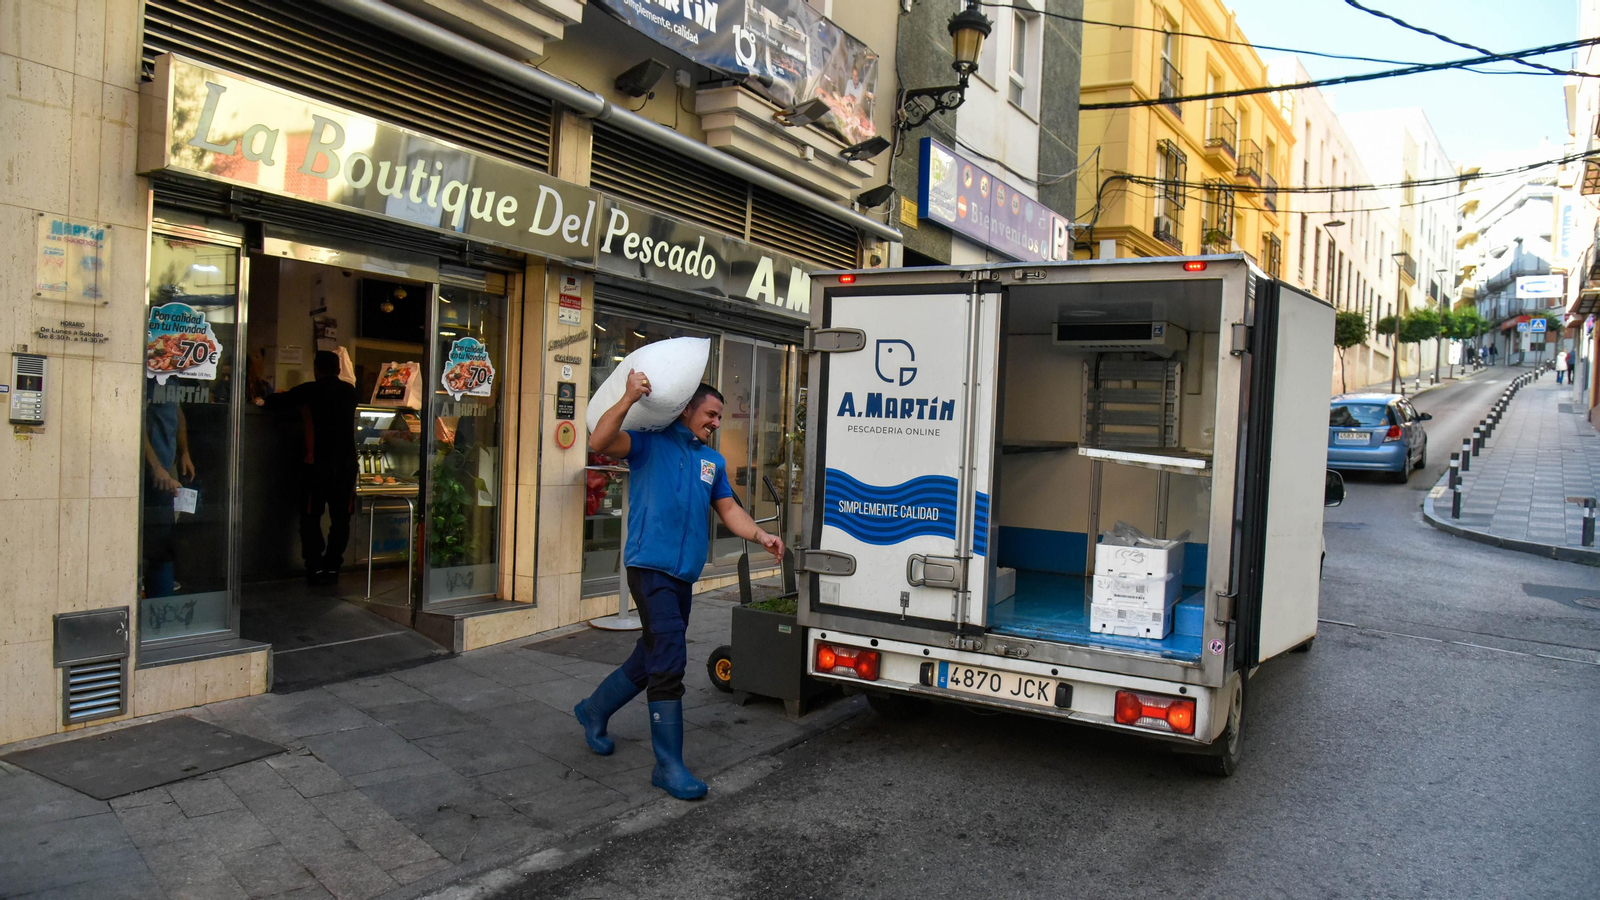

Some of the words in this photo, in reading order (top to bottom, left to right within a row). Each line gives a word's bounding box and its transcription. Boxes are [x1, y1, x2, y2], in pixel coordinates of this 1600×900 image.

[673, 24, 699, 45] calidad
[188, 80, 280, 167] La
[297, 114, 519, 227] Boutique
[528, 184, 597, 247] Del
[600, 207, 717, 280] Pescado
[971, 201, 1039, 254] Bienvenidos
[1052, 216, 1066, 260] P
[561, 296, 581, 305] Alarma
[60, 320, 85, 329] HORARIO
[153, 310, 171, 321] Pon
[171, 313, 203, 325] calidad
[149, 322, 160, 330] en
[161, 322, 171, 332] tu
[172, 323, 208, 334] Navidad
[177, 340, 218, 367] 70€
[453, 343, 465, 352] Pon
[465, 345, 484, 354] calidad
[468, 367, 493, 387] 70€
[847, 424, 903, 435] PESCADERIA
[905, 427, 941, 437] ONLINE
[838, 500, 898, 518] SIMPLEMENTE
[900, 505, 939, 521] CALIDAD
[950, 666, 1002, 692] 4870
[1010, 677, 1050, 702] JCK
